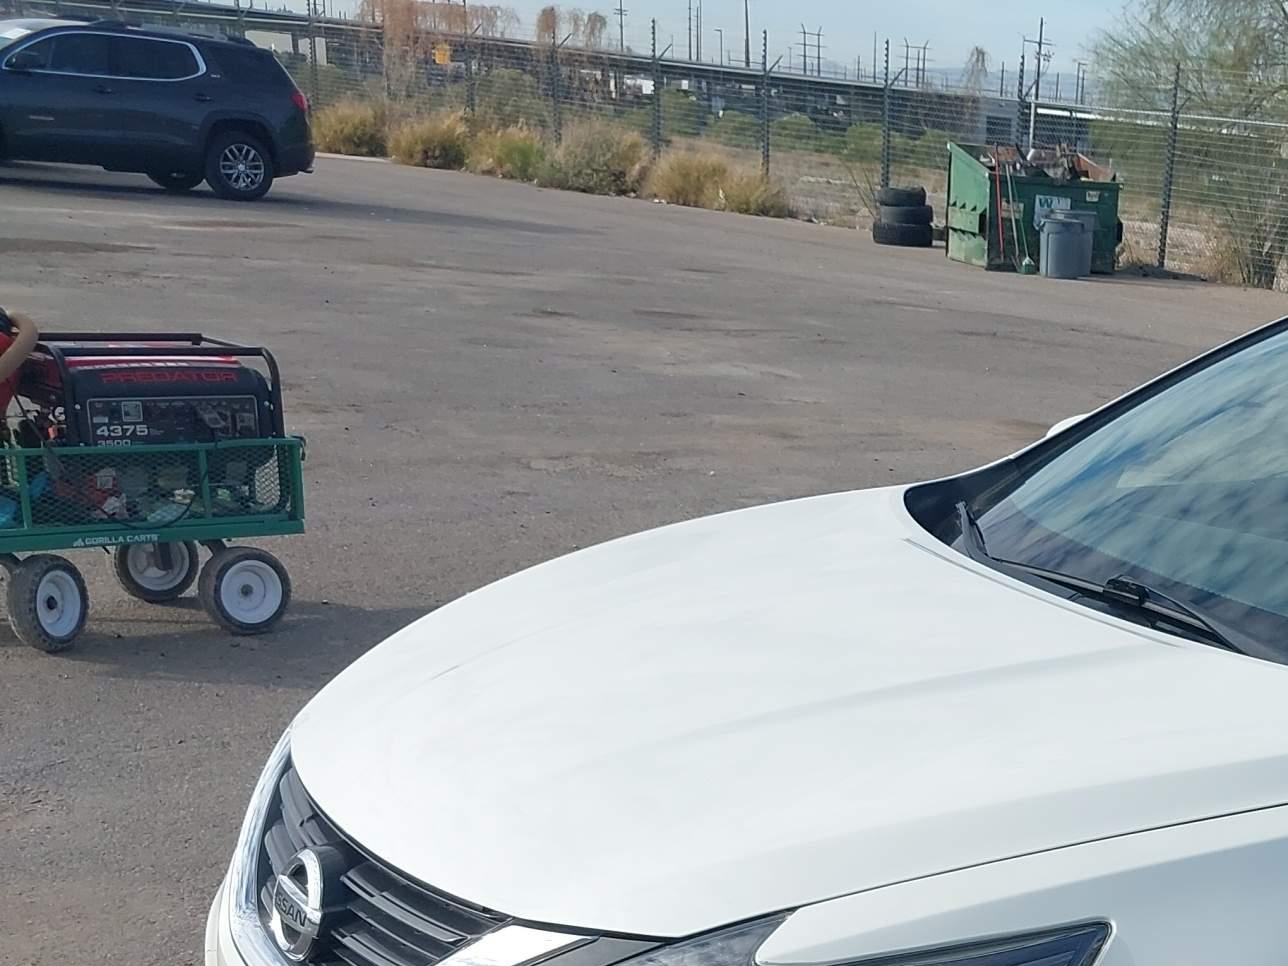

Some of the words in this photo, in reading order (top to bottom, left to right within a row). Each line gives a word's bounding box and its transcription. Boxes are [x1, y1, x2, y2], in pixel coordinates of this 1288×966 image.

[100, 371, 240, 384] PREDATOR
[96, 425, 149, 436] 4375
[85, 535, 124, 545] GORILLA
[126, 533, 158, 543] CARTS
